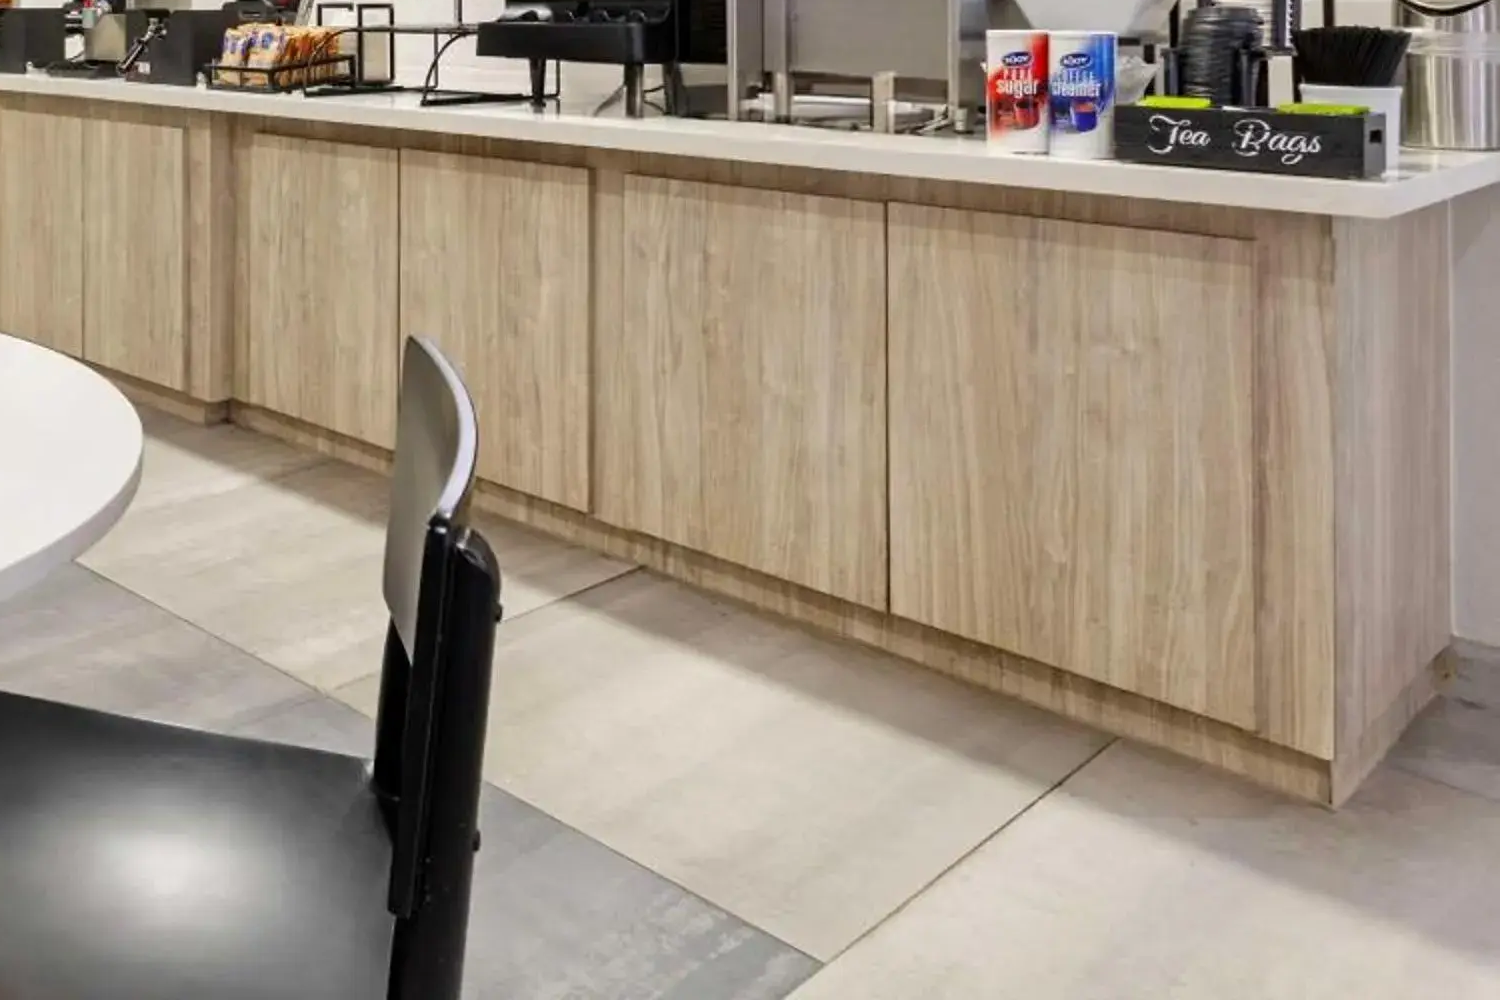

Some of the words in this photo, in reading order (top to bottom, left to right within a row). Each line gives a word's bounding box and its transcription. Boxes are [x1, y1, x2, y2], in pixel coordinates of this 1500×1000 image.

[996, 79, 1039, 98] sugar
[1148, 114, 1211, 154] Tea
[1232, 118, 1322, 165] Bags
